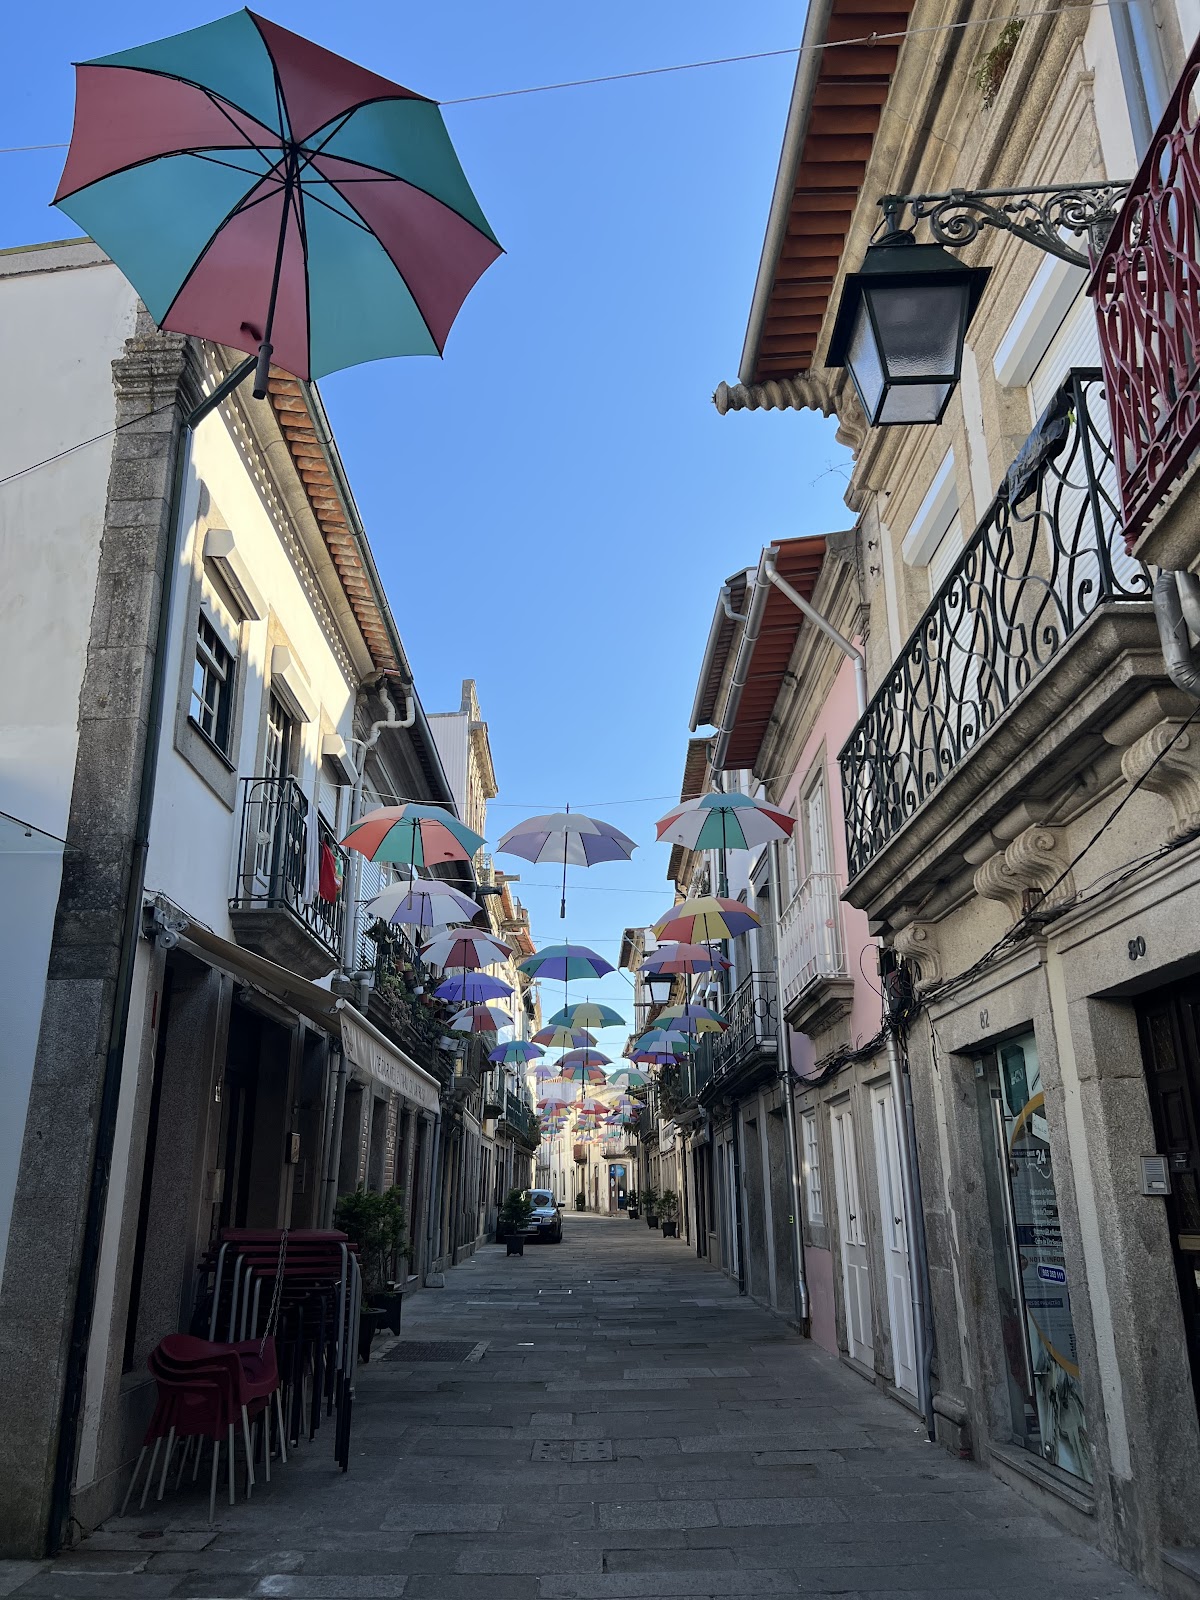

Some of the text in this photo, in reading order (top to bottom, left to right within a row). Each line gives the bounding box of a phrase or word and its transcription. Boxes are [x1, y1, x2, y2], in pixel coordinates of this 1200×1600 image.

[1128, 935, 1146, 961] 80
[980, 1008, 990, 1030] 82
[1036, 1149, 1047, 1165] 24
